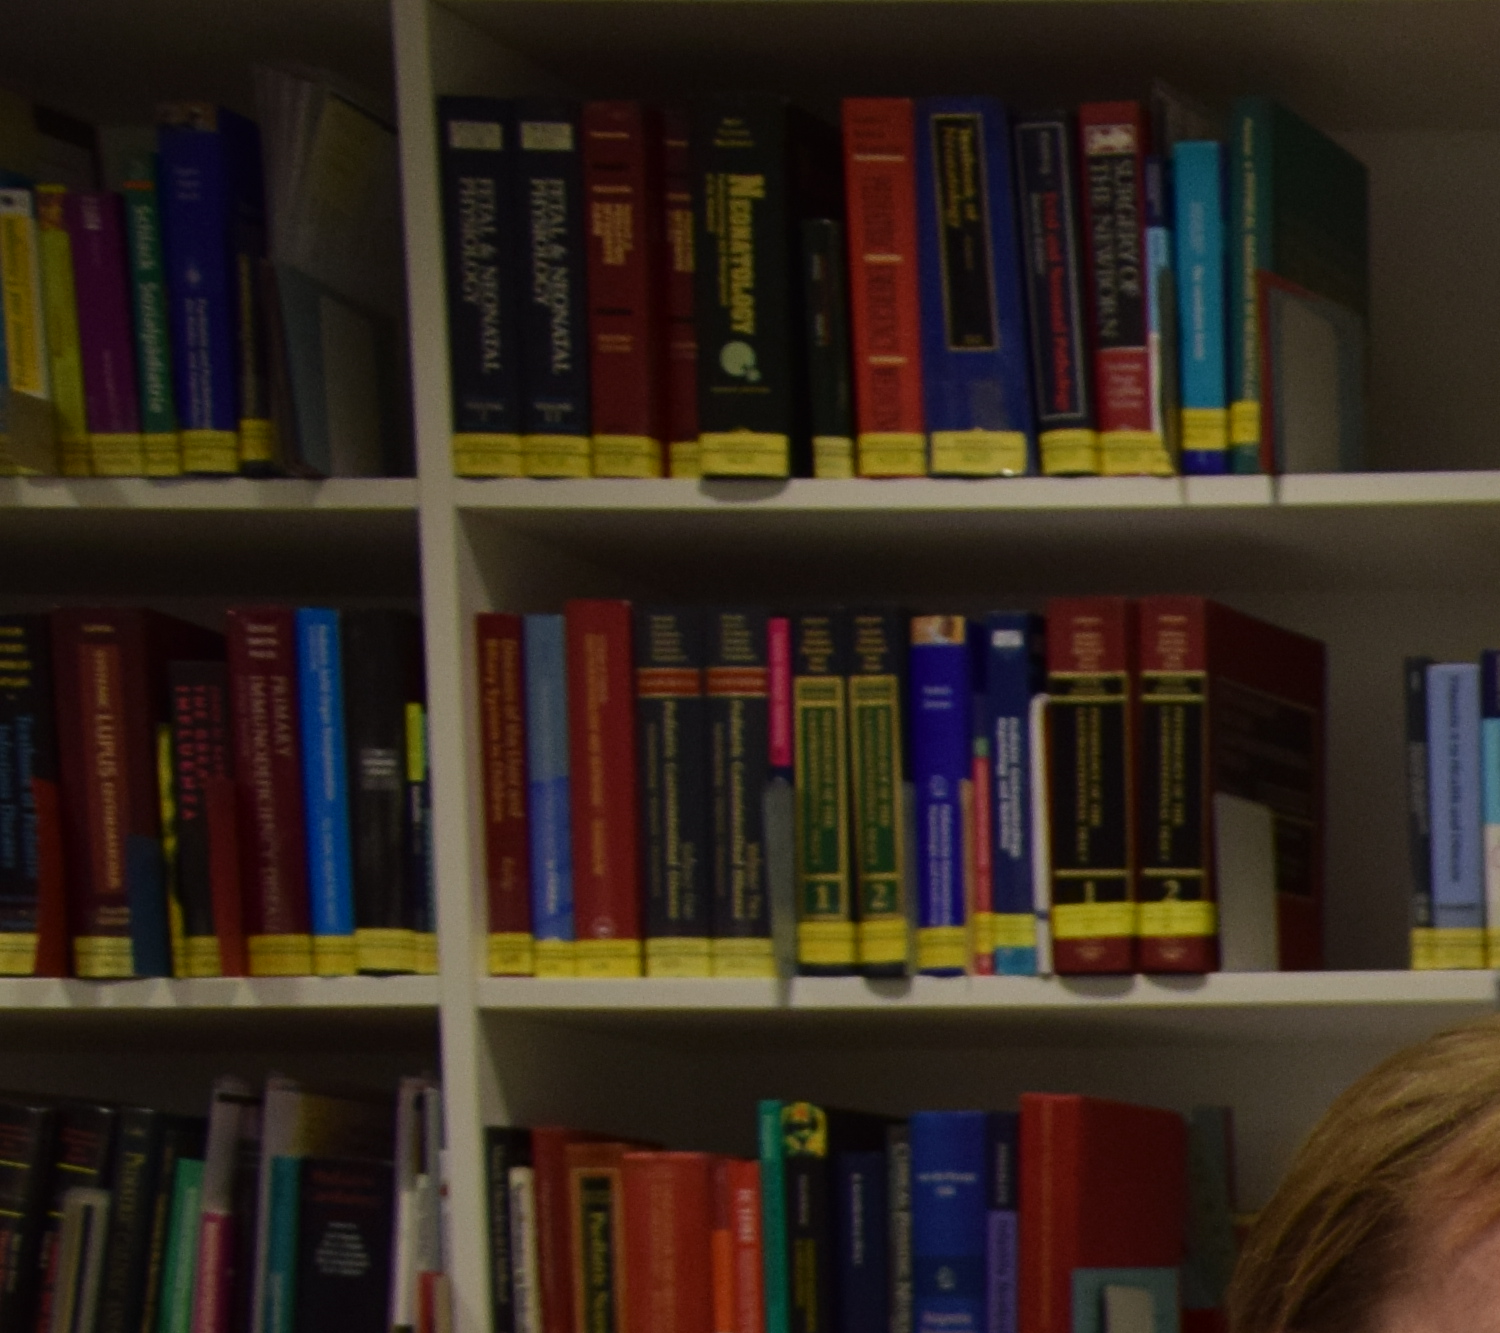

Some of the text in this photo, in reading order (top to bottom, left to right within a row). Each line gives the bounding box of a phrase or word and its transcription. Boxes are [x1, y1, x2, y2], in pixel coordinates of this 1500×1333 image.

[459, 178, 480, 307] PHYSIOLOGY
[481, 179, 503, 375] FETAL & NEONATAL
[529, 178, 550, 308] PHYSIOLOGY
[549, 179, 573, 376] FETAL & NEONATAL
[727, 172, 767, 336] NEONATOLOGY
[1089, 162, 1119, 340] THE NEWBORN
[1112, 160, 1139, 297] SURGERY OF
[93, 713, 115, 778] LUPUS
[173, 684, 197, 820] INFLUENZA
[247, 674, 278, 860] IMMUNODEFICIENCY
[271, 674, 292, 758] PRIMARY
[871, 885, 888, 911] 2
